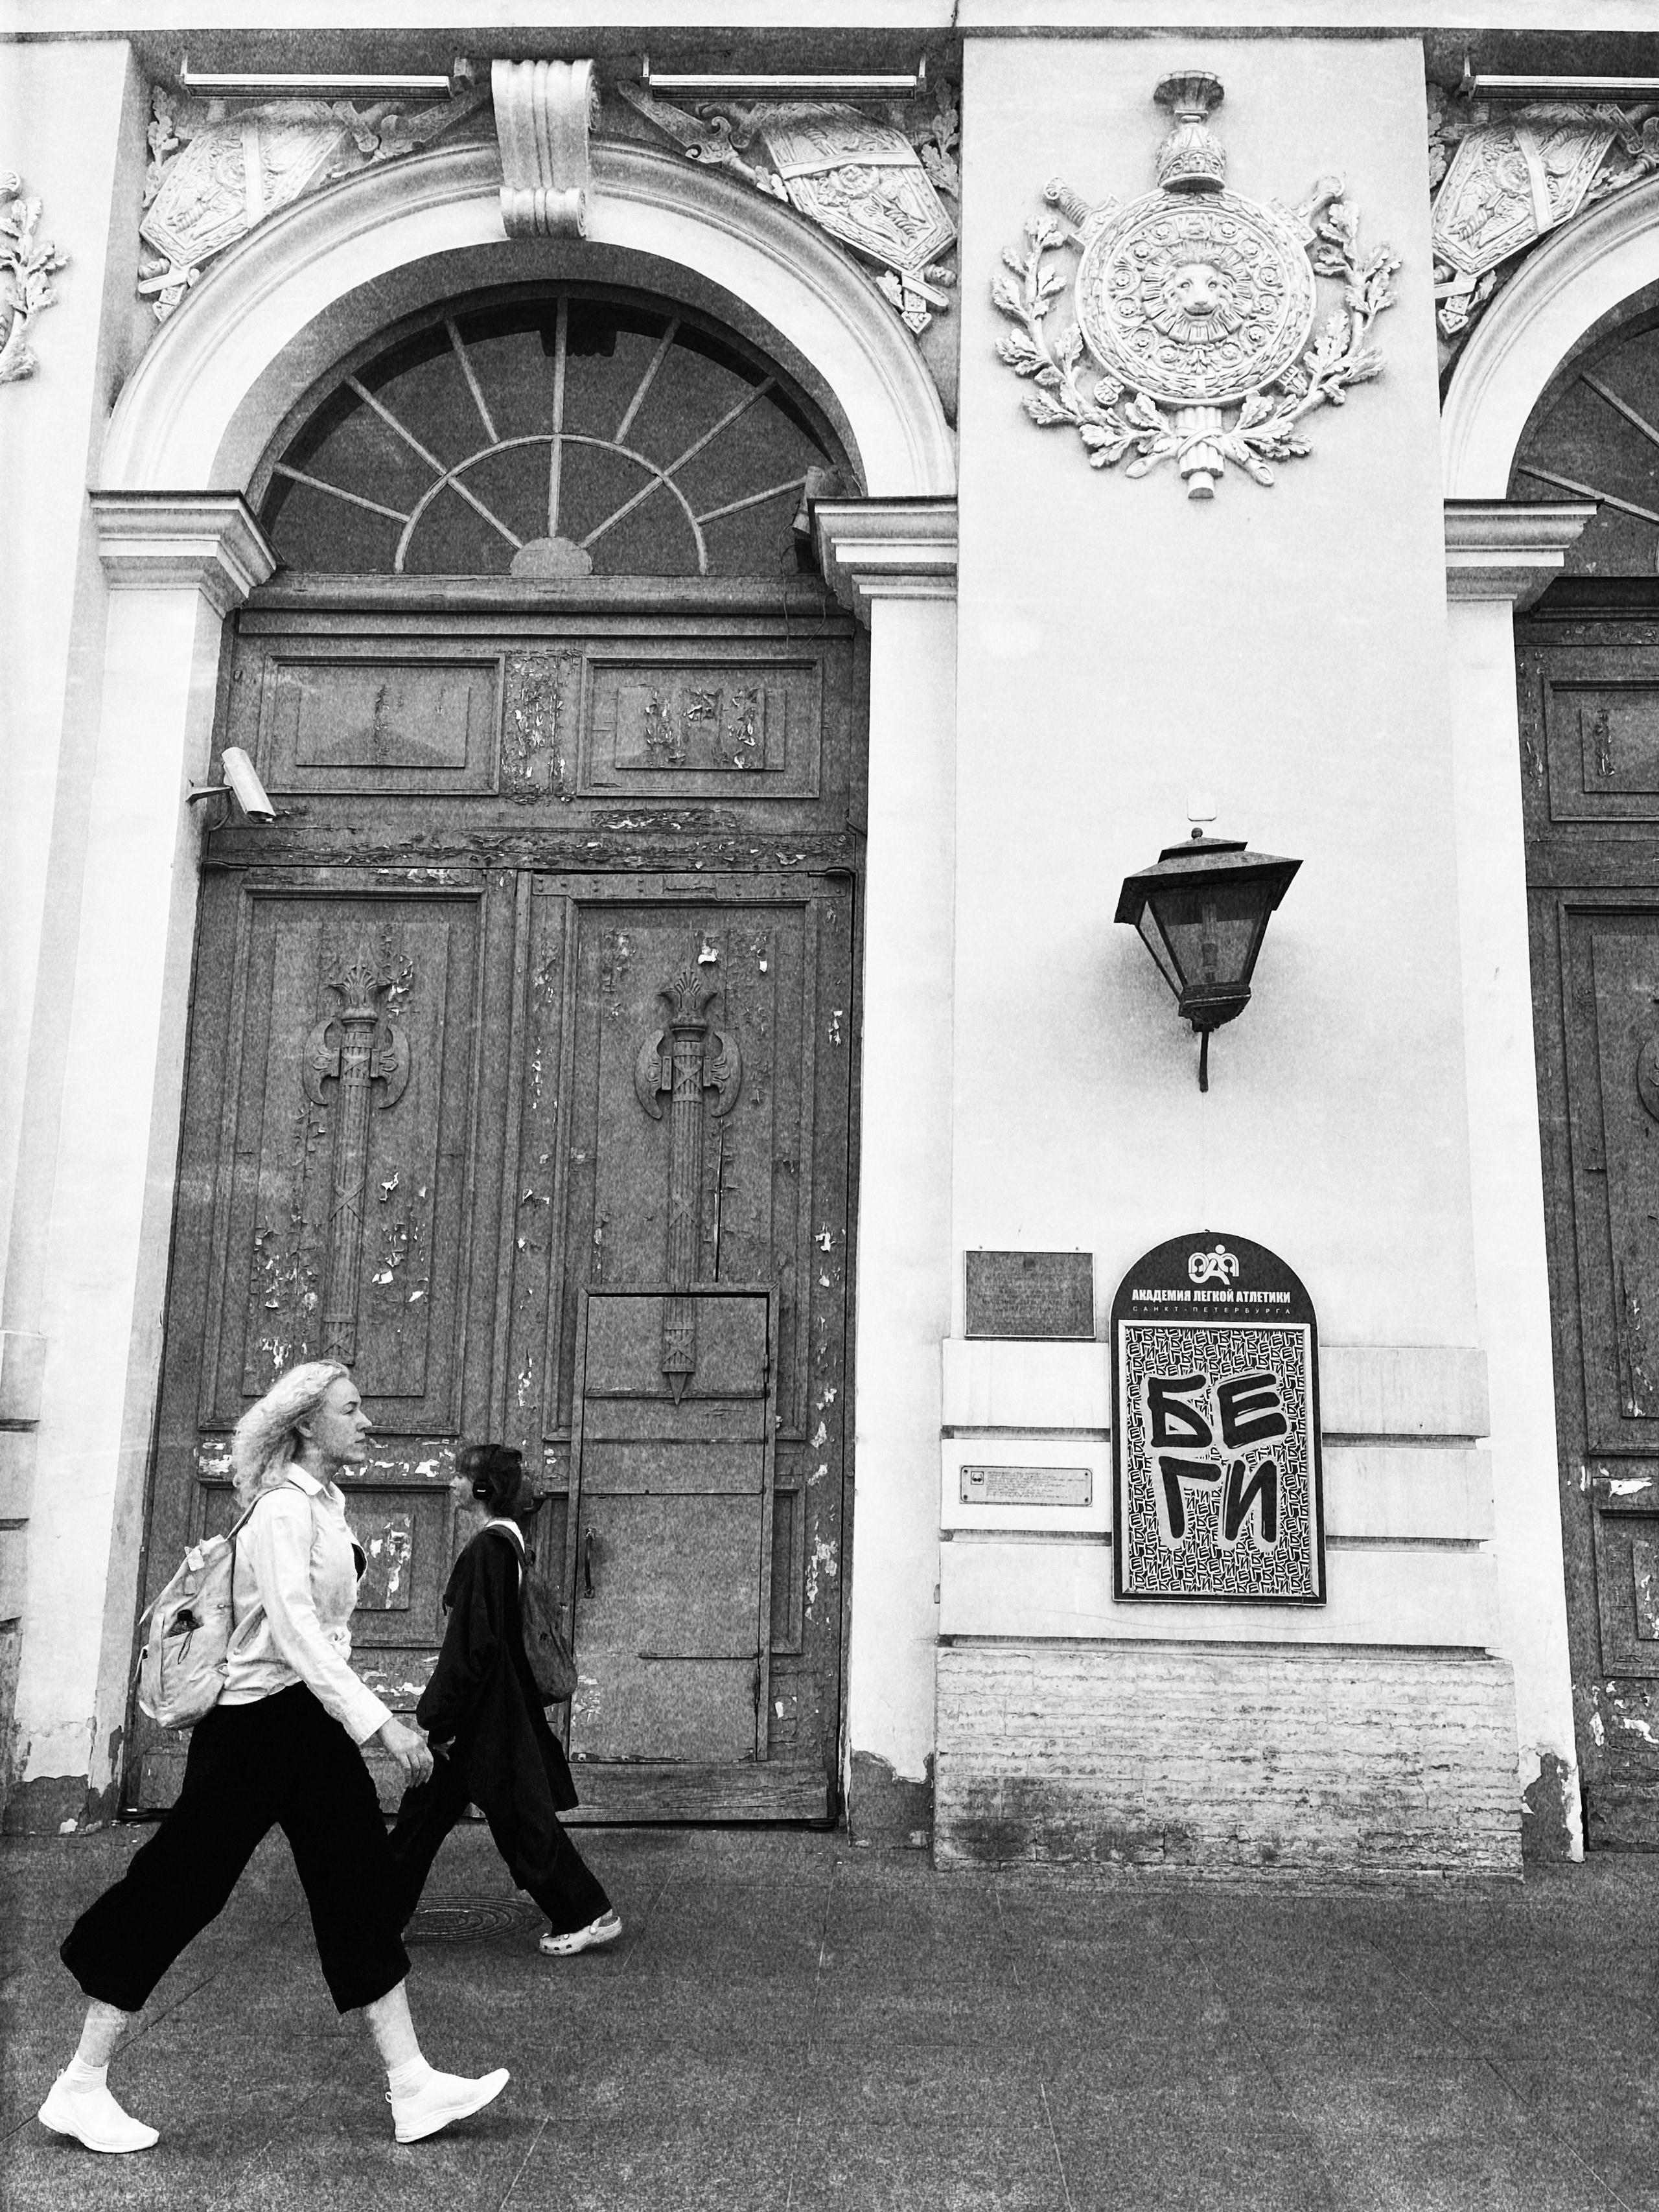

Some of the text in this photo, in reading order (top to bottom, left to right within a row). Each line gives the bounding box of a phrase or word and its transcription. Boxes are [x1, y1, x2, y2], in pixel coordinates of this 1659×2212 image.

[1131, 1289, 1290, 1303] АКАДЕМИЯ ЛЕГКОЙ АТЛЕТИКИ
[1133, 1306, 1291, 1314] САНКТ-ПЕТЕРБУРГА
